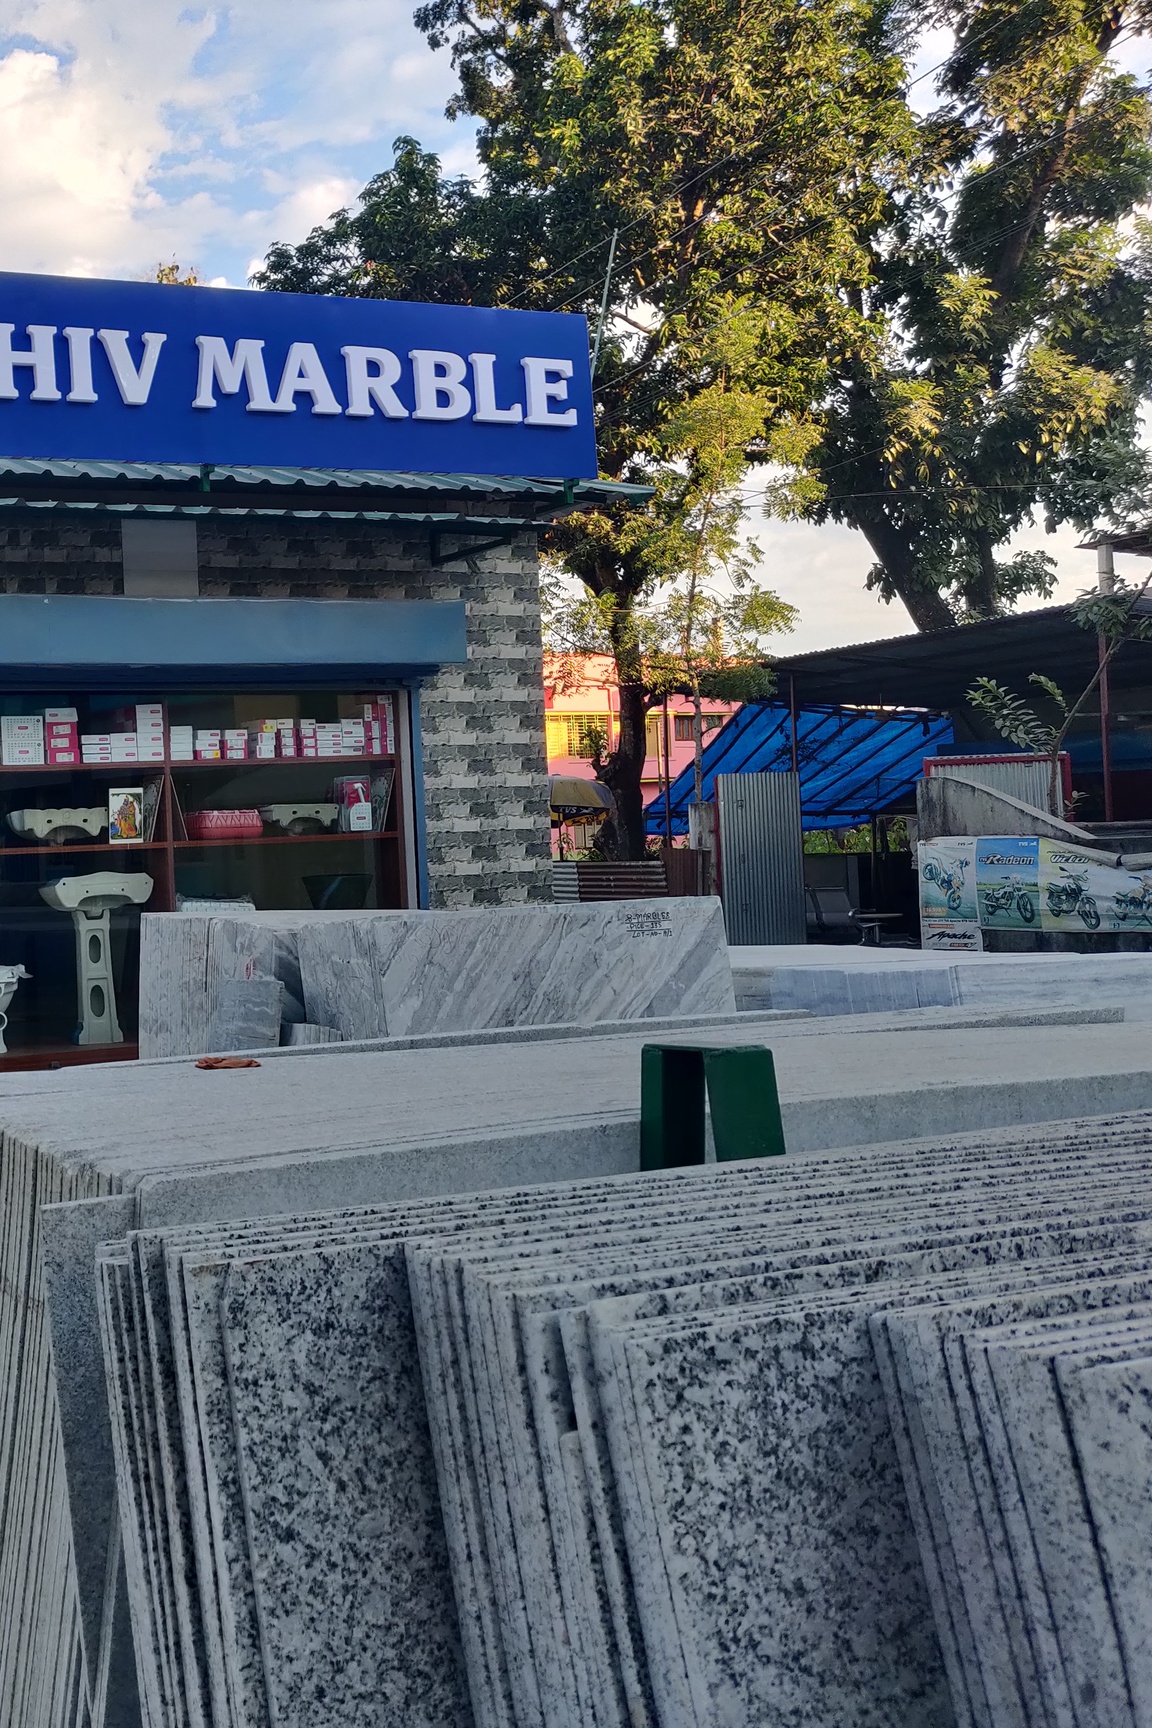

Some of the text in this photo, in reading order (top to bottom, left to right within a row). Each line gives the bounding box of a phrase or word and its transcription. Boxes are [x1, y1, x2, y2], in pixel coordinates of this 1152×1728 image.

[191, 336, 579, 427] MARBLE
[558, 806, 578, 814] TVS
[986, 854, 1036, 865] Radeon
[926, 930, 977, 941] Apache
